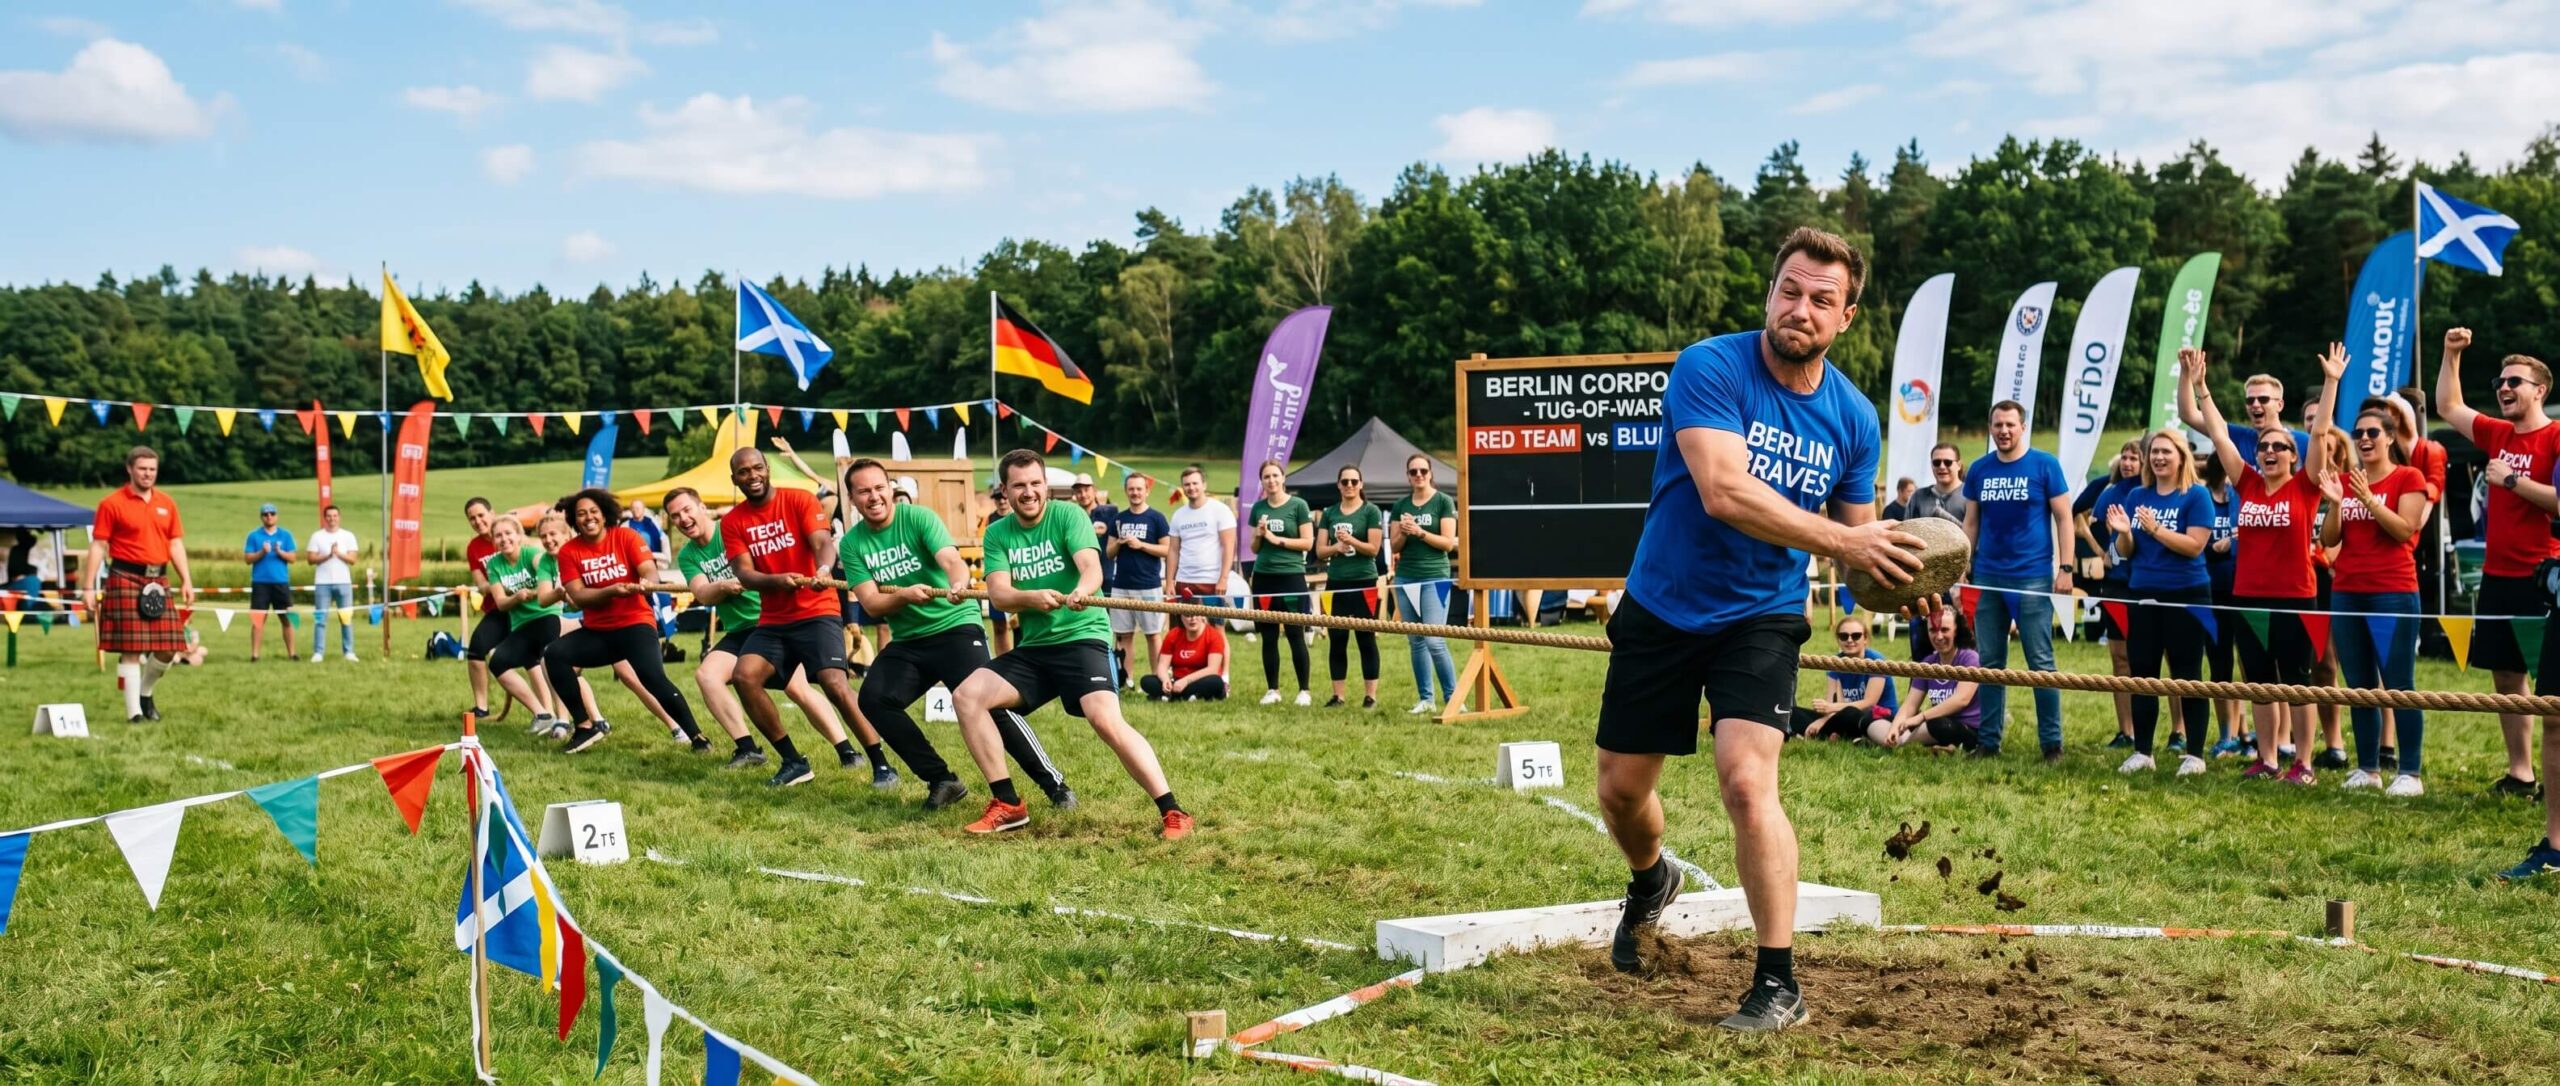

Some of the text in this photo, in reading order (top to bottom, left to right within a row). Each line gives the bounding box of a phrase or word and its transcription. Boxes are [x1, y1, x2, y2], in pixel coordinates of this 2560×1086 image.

[1486, 375, 1573, 398] BERLIN
[2075, 341, 2107, 434] UFDO
[1534, 398, 1663, 419] TUG-OF-WAR
[1475, 431, 1515, 449] RED
[1521, 429, 1576, 448] TEAM
[1617, 427, 1663, 445] BLU
[1746, 420, 1834, 471] BERLIN
[1983, 476, 2028, 489] BERLIN
[1980, 488, 2029, 501] BRAVES
[2240, 500, 2290, 515] BERLIN
[745, 519, 785, 542] TECH
[2238, 512, 2291, 527] BRAVES
[749, 532, 796, 558] TITANS
[864, 542, 912, 570] MEDIA
[1008, 539, 1057, 564] MEDIA
[581, 552, 616, 571] TECH
[582, 563, 628, 586] TITANS
[933, 698, 945, 713] 4
[1522, 758, 1535, 780] 5
[582, 823, 599, 850] 2
